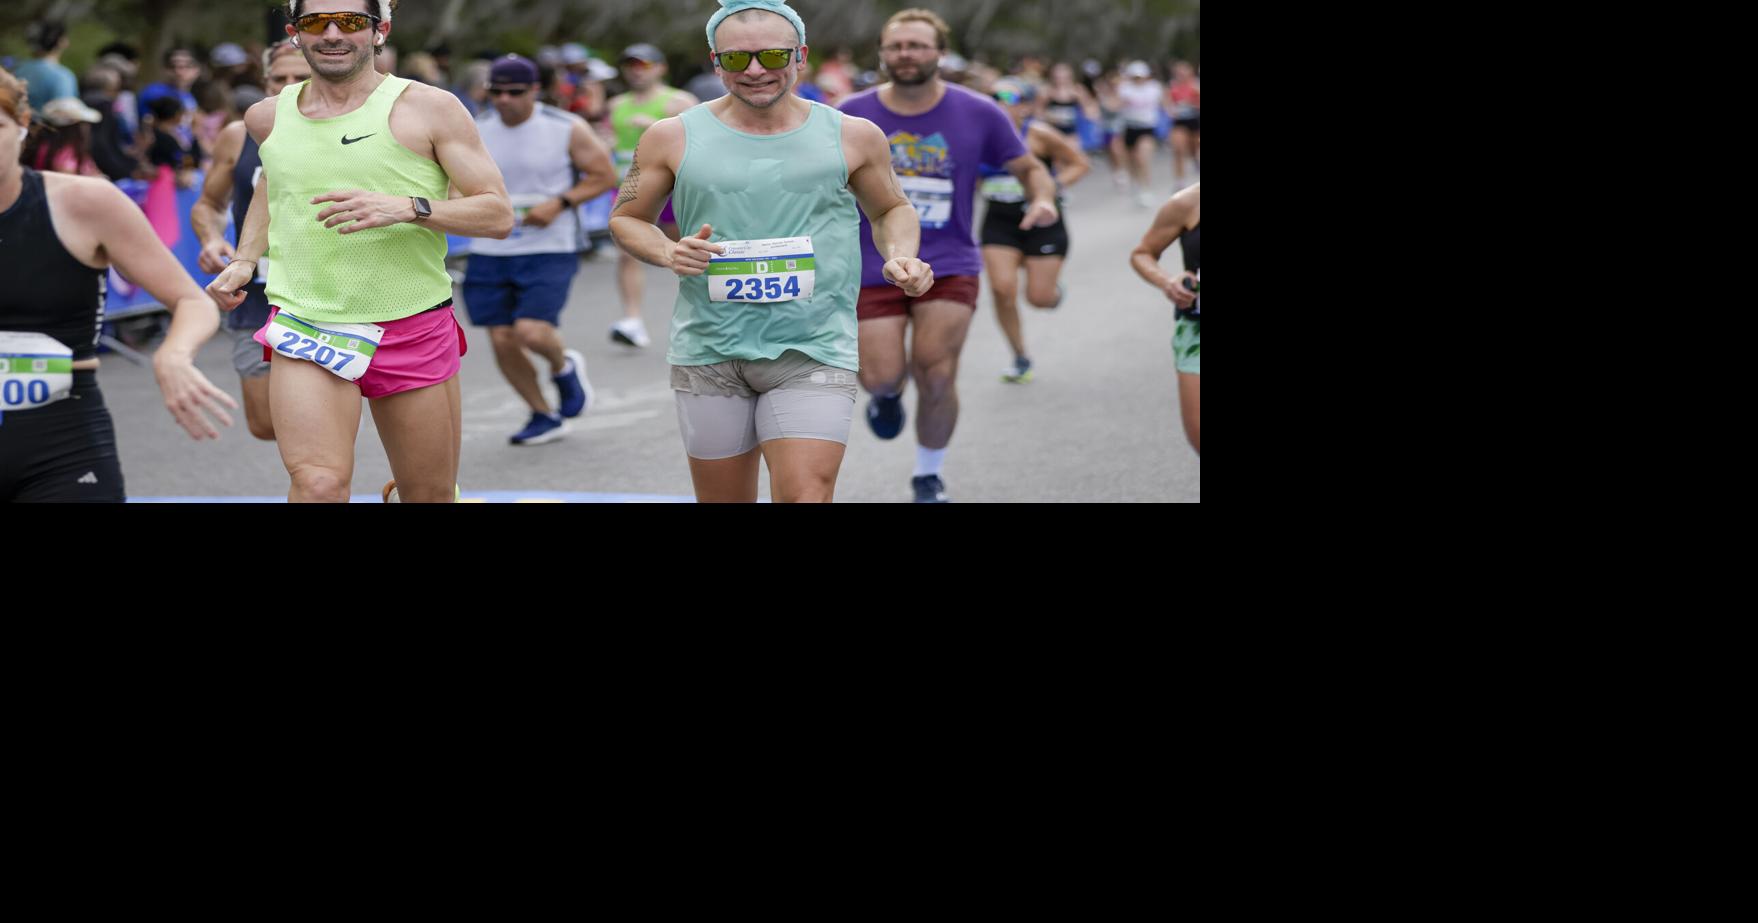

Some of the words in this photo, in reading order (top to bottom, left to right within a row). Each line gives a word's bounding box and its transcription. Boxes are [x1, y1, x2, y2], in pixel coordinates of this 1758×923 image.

[756, 261, 769, 274] D
[725, 275, 801, 300] 2354
[276, 331, 356, 372] 2207
